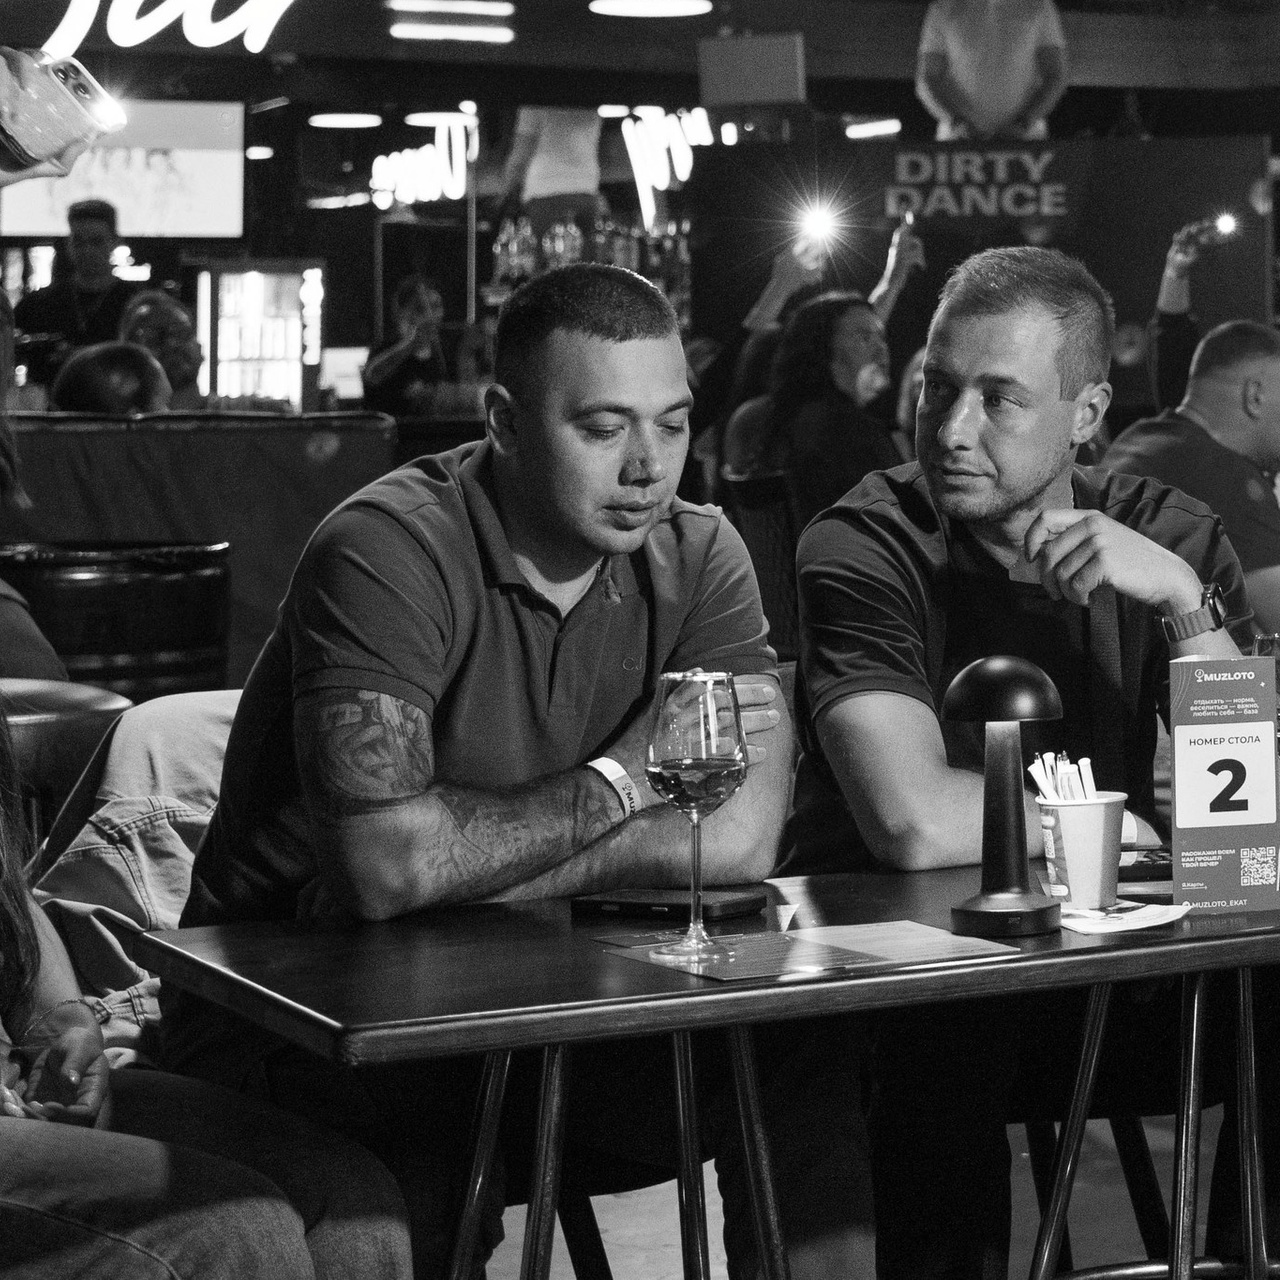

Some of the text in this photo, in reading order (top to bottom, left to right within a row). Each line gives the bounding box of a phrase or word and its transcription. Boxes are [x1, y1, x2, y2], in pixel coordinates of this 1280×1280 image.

[895, 150, 1055, 183] DIRTY
[884, 183, 1069, 218] DANCE
[1204, 671, 1255, 682] MUZLOTO
[1189, 735, 1261, 746] НОМЕР СТОЛА
[1206, 758, 1248, 813] 2
[1191, 900, 1247, 908] MUZLOTO_EKAT
